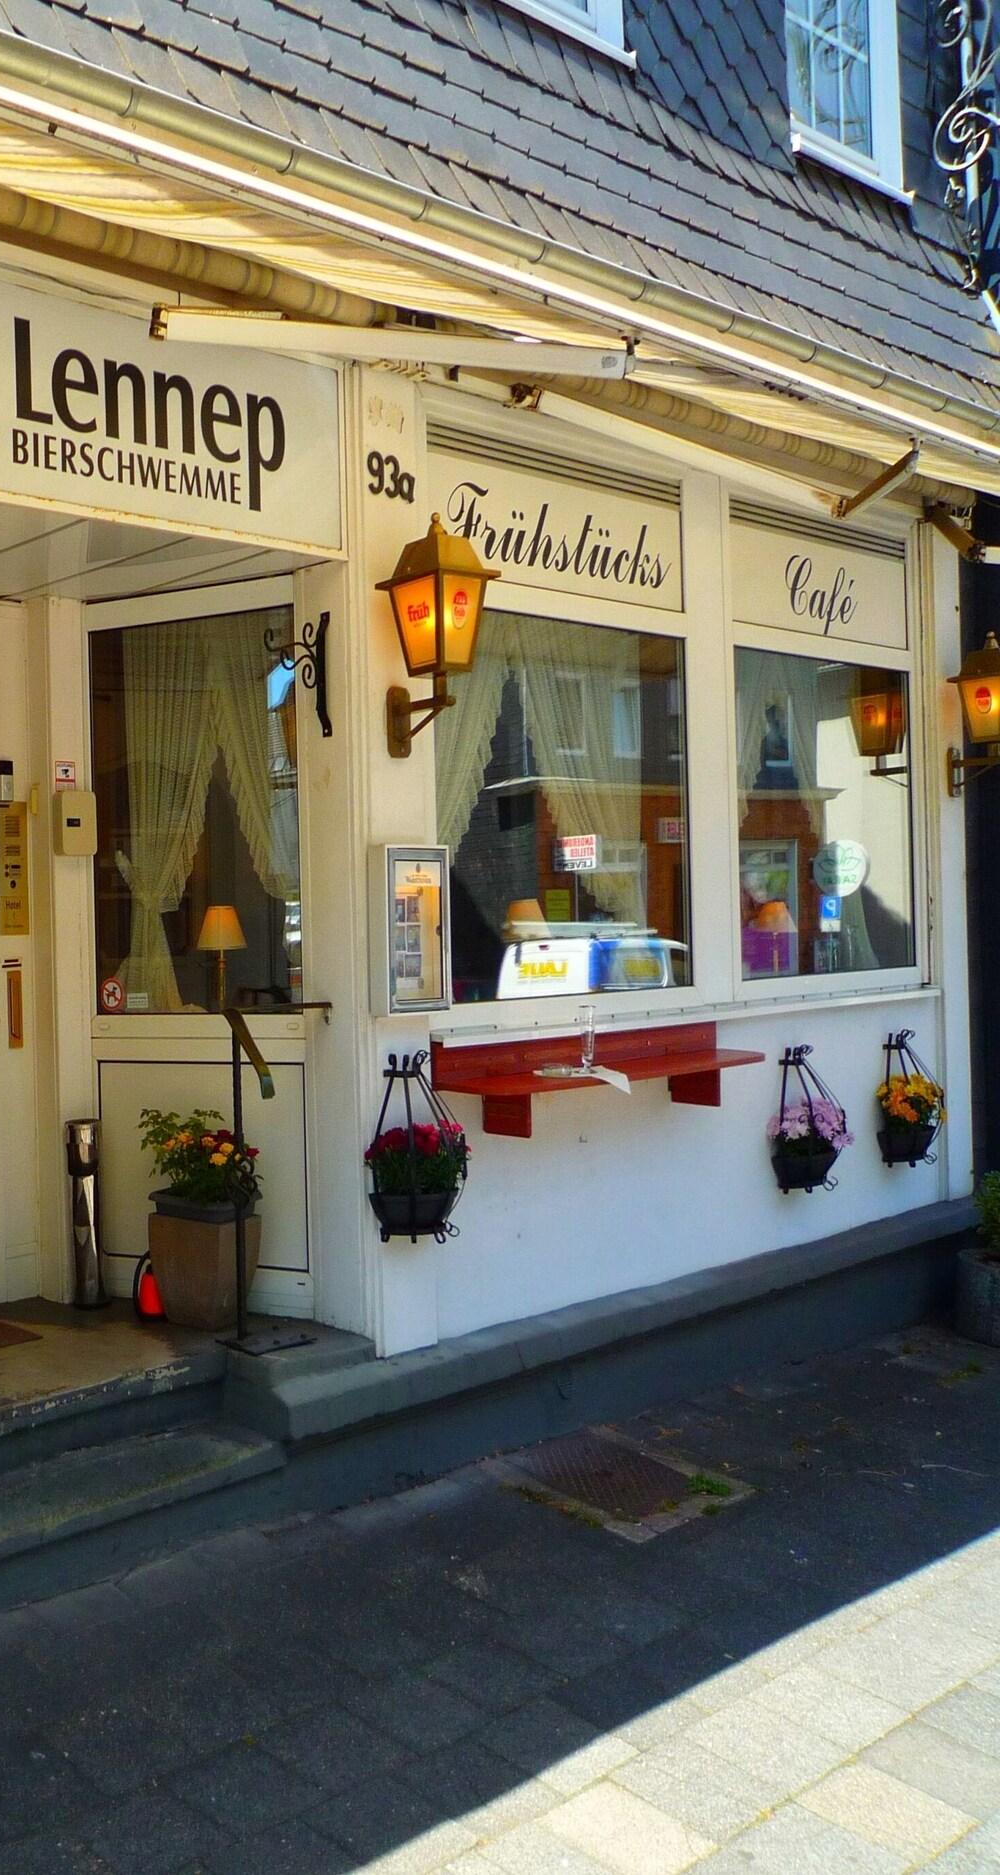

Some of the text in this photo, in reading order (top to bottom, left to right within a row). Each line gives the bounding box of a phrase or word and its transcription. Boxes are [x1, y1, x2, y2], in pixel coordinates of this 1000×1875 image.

[14, 316, 286, 512] Lennep
[12, 429, 242, 505] BIERSCHWEMME
[367, 451, 415, 504] 93a
[447, 482, 672, 589] Frühstücks
[407, 601, 430, 622] früh
[785, 555, 859, 635] Café
[6, 900, 21, 910] Hotel
